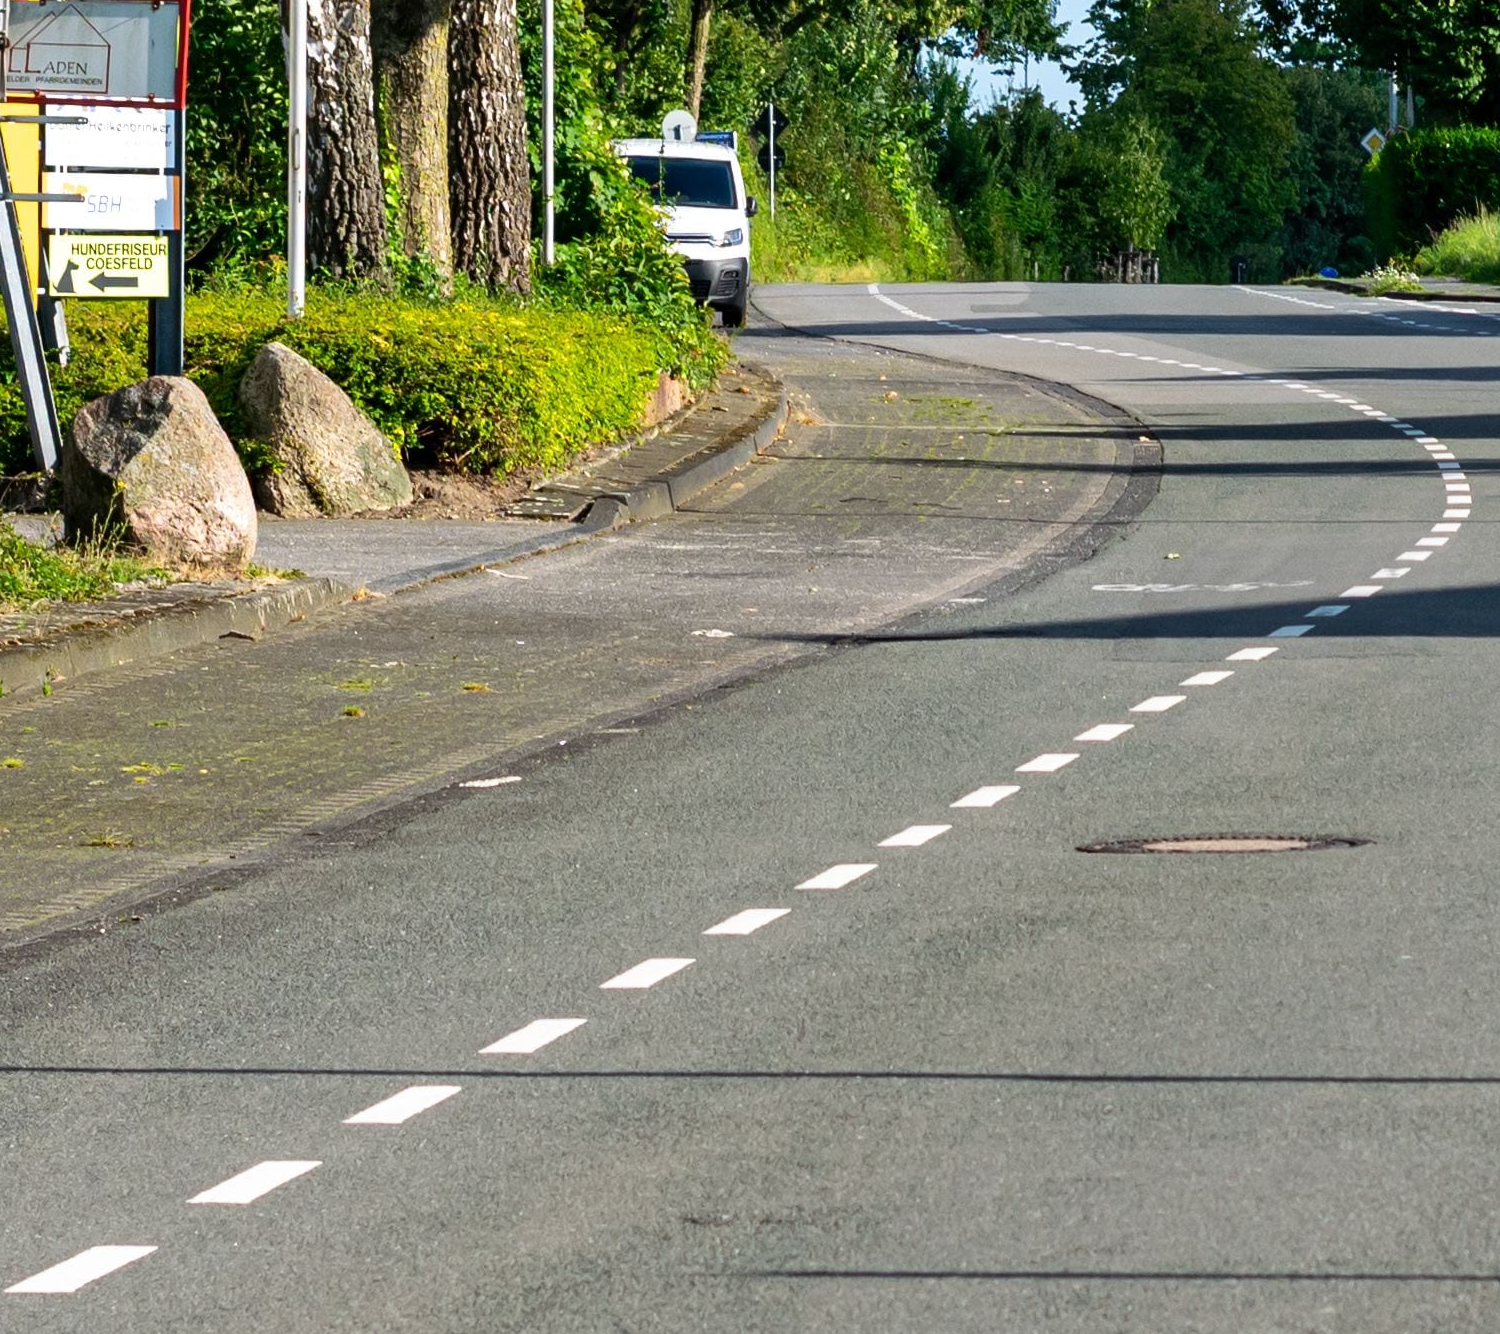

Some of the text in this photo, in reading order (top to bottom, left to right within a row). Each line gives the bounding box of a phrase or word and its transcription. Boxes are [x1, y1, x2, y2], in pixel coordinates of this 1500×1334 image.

[87, 195, 122, 213] SBH
[71, 243, 167, 255] HUNDEFRISEUR
[86, 257, 153, 270] COESFELD
